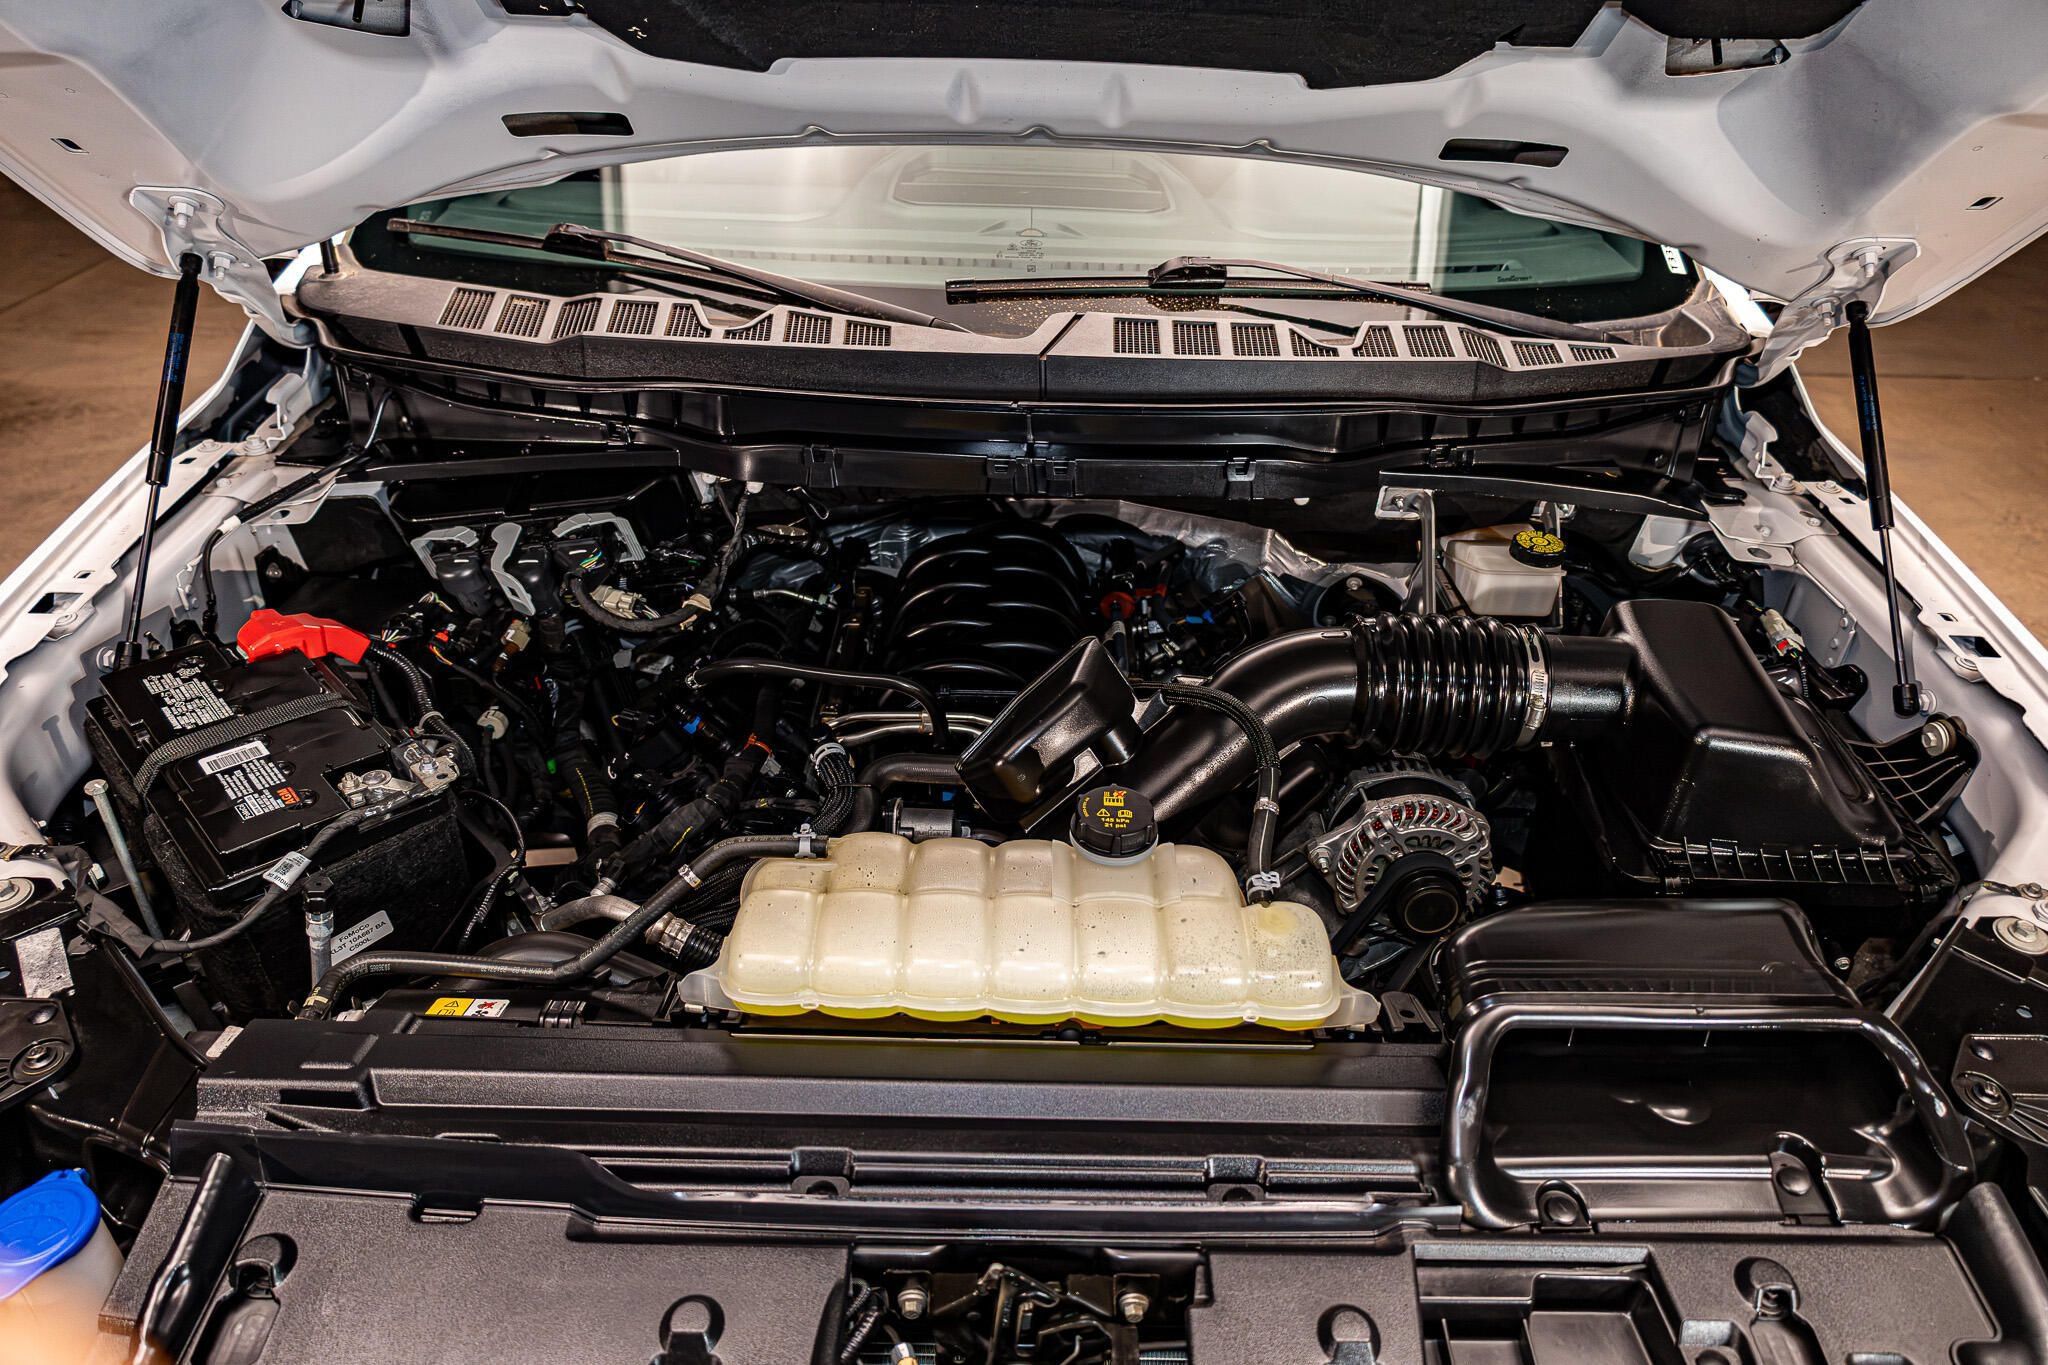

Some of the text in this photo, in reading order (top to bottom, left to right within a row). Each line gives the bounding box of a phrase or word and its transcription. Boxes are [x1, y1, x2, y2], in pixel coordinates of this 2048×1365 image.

[278, 787, 297, 805] AGM
[338, 923, 370, 942] FoMoCo
[349, 928, 374, 944] 10A687
